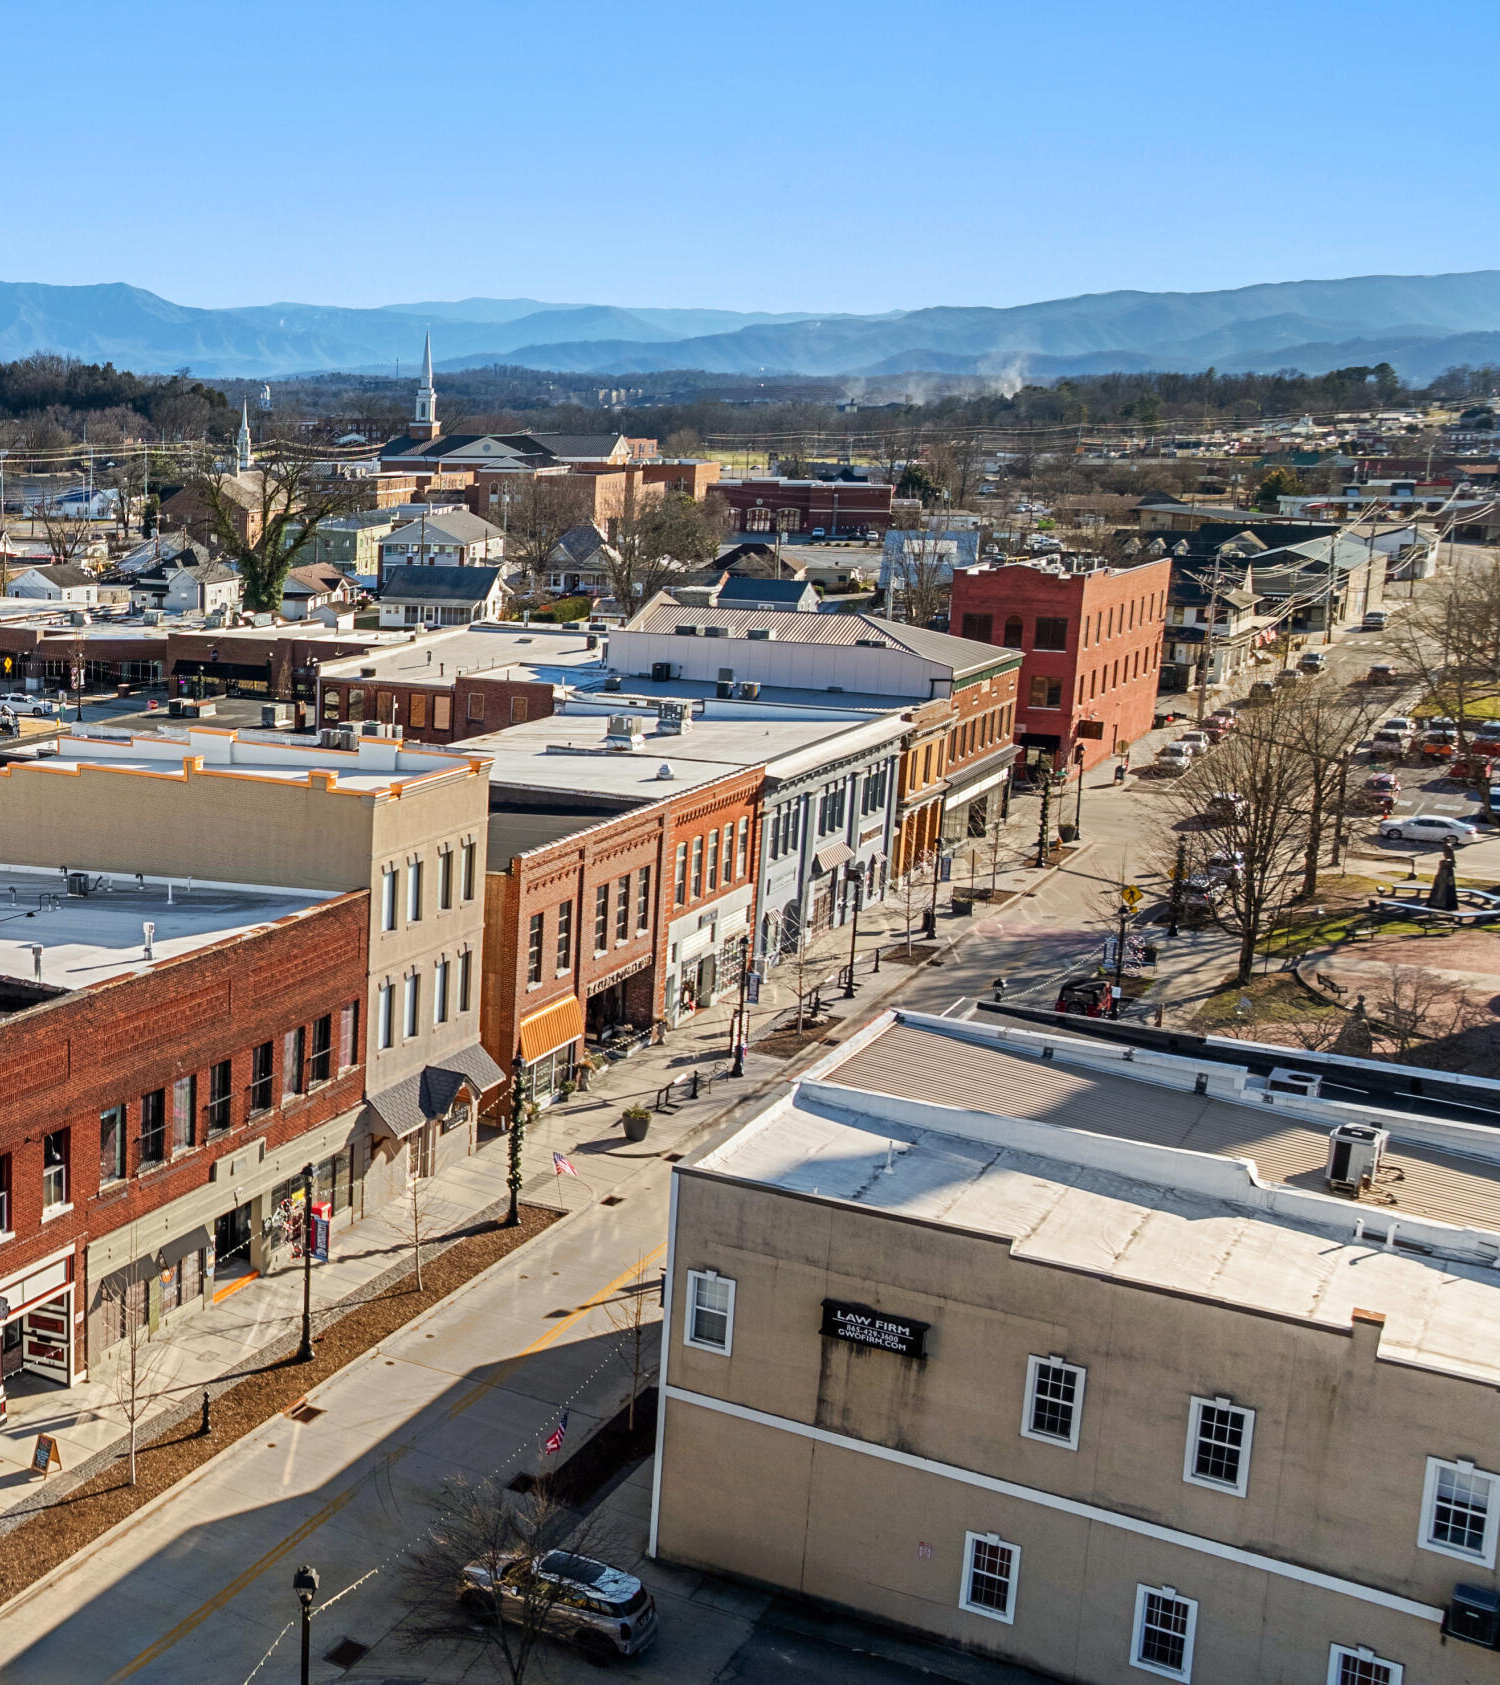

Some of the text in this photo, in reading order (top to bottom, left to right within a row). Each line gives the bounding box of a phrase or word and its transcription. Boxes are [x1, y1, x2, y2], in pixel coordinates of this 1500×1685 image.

[836, 1310, 910, 1336] LAW FIRM
[846, 1324, 899, 1343] 865-429-3600
[837, 1328, 907, 1352] GWOFIRM.COM
